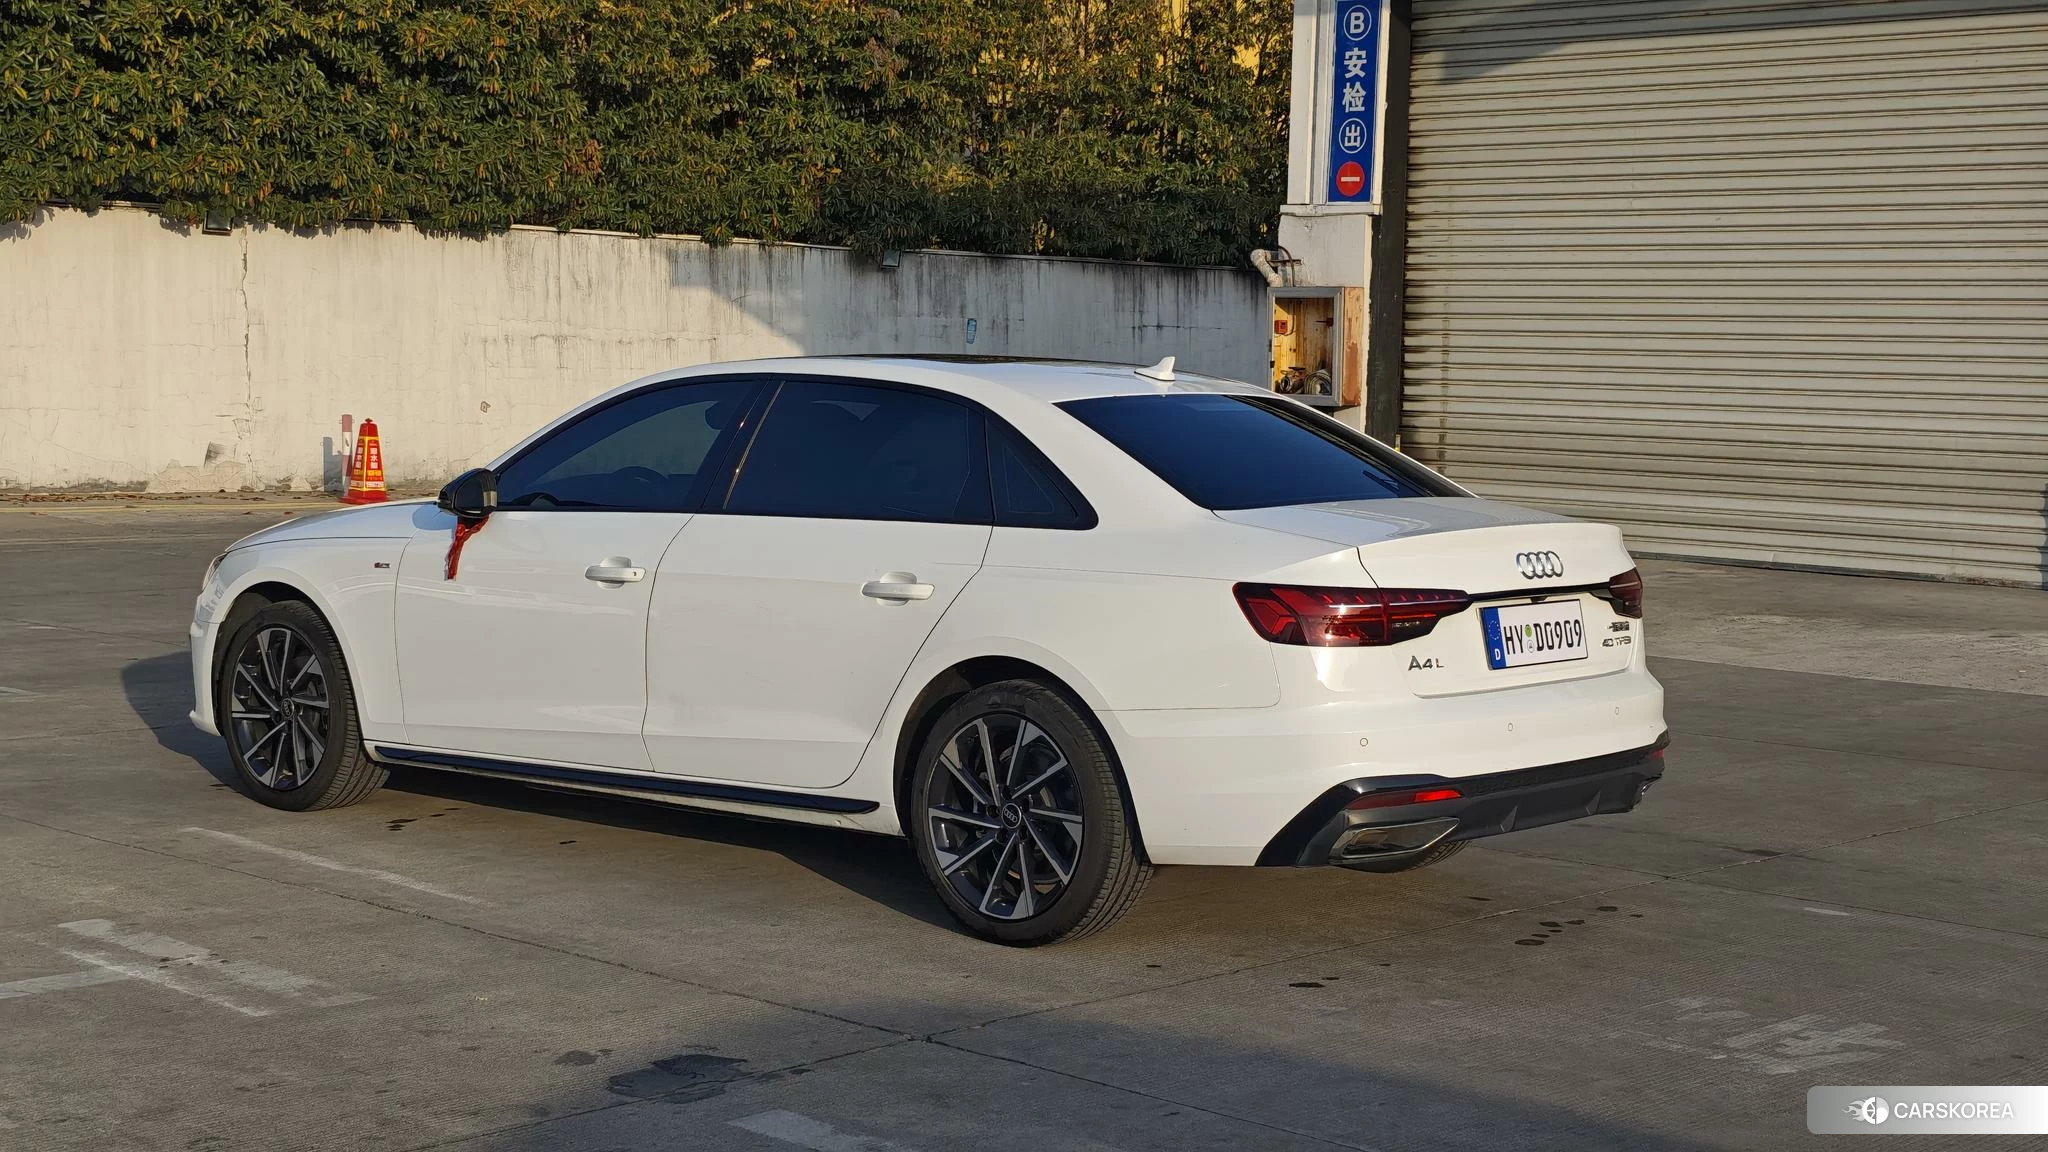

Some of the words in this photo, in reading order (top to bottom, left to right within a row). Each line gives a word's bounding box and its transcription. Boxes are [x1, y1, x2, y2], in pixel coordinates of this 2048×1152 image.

[1350, 12, 1365, 34] B
[1503, 624, 1524, 655] HY
[1494, 648, 1501, 661] D
